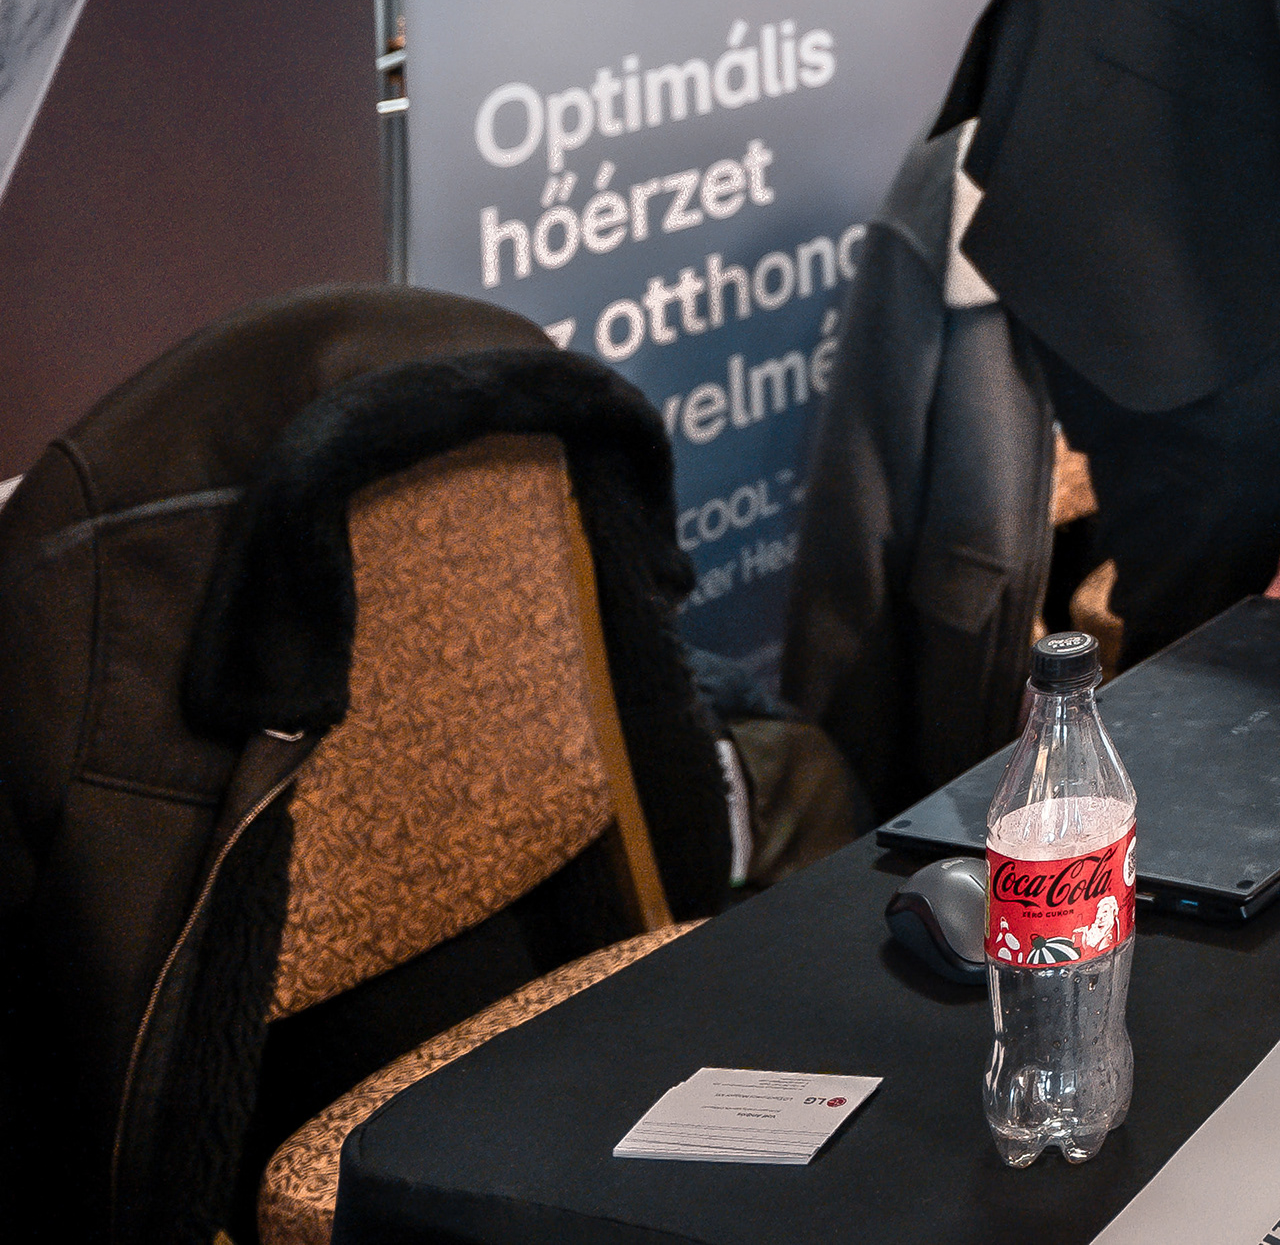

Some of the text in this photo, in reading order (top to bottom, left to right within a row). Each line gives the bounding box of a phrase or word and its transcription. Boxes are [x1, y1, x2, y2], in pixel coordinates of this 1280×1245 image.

[474, 18, 838, 174] Optimális
[479, 138, 776, 289] hőérzet
[992, 843, 1118, 909] Coca-Cola
[803, 1096, 827, 1106] LG
